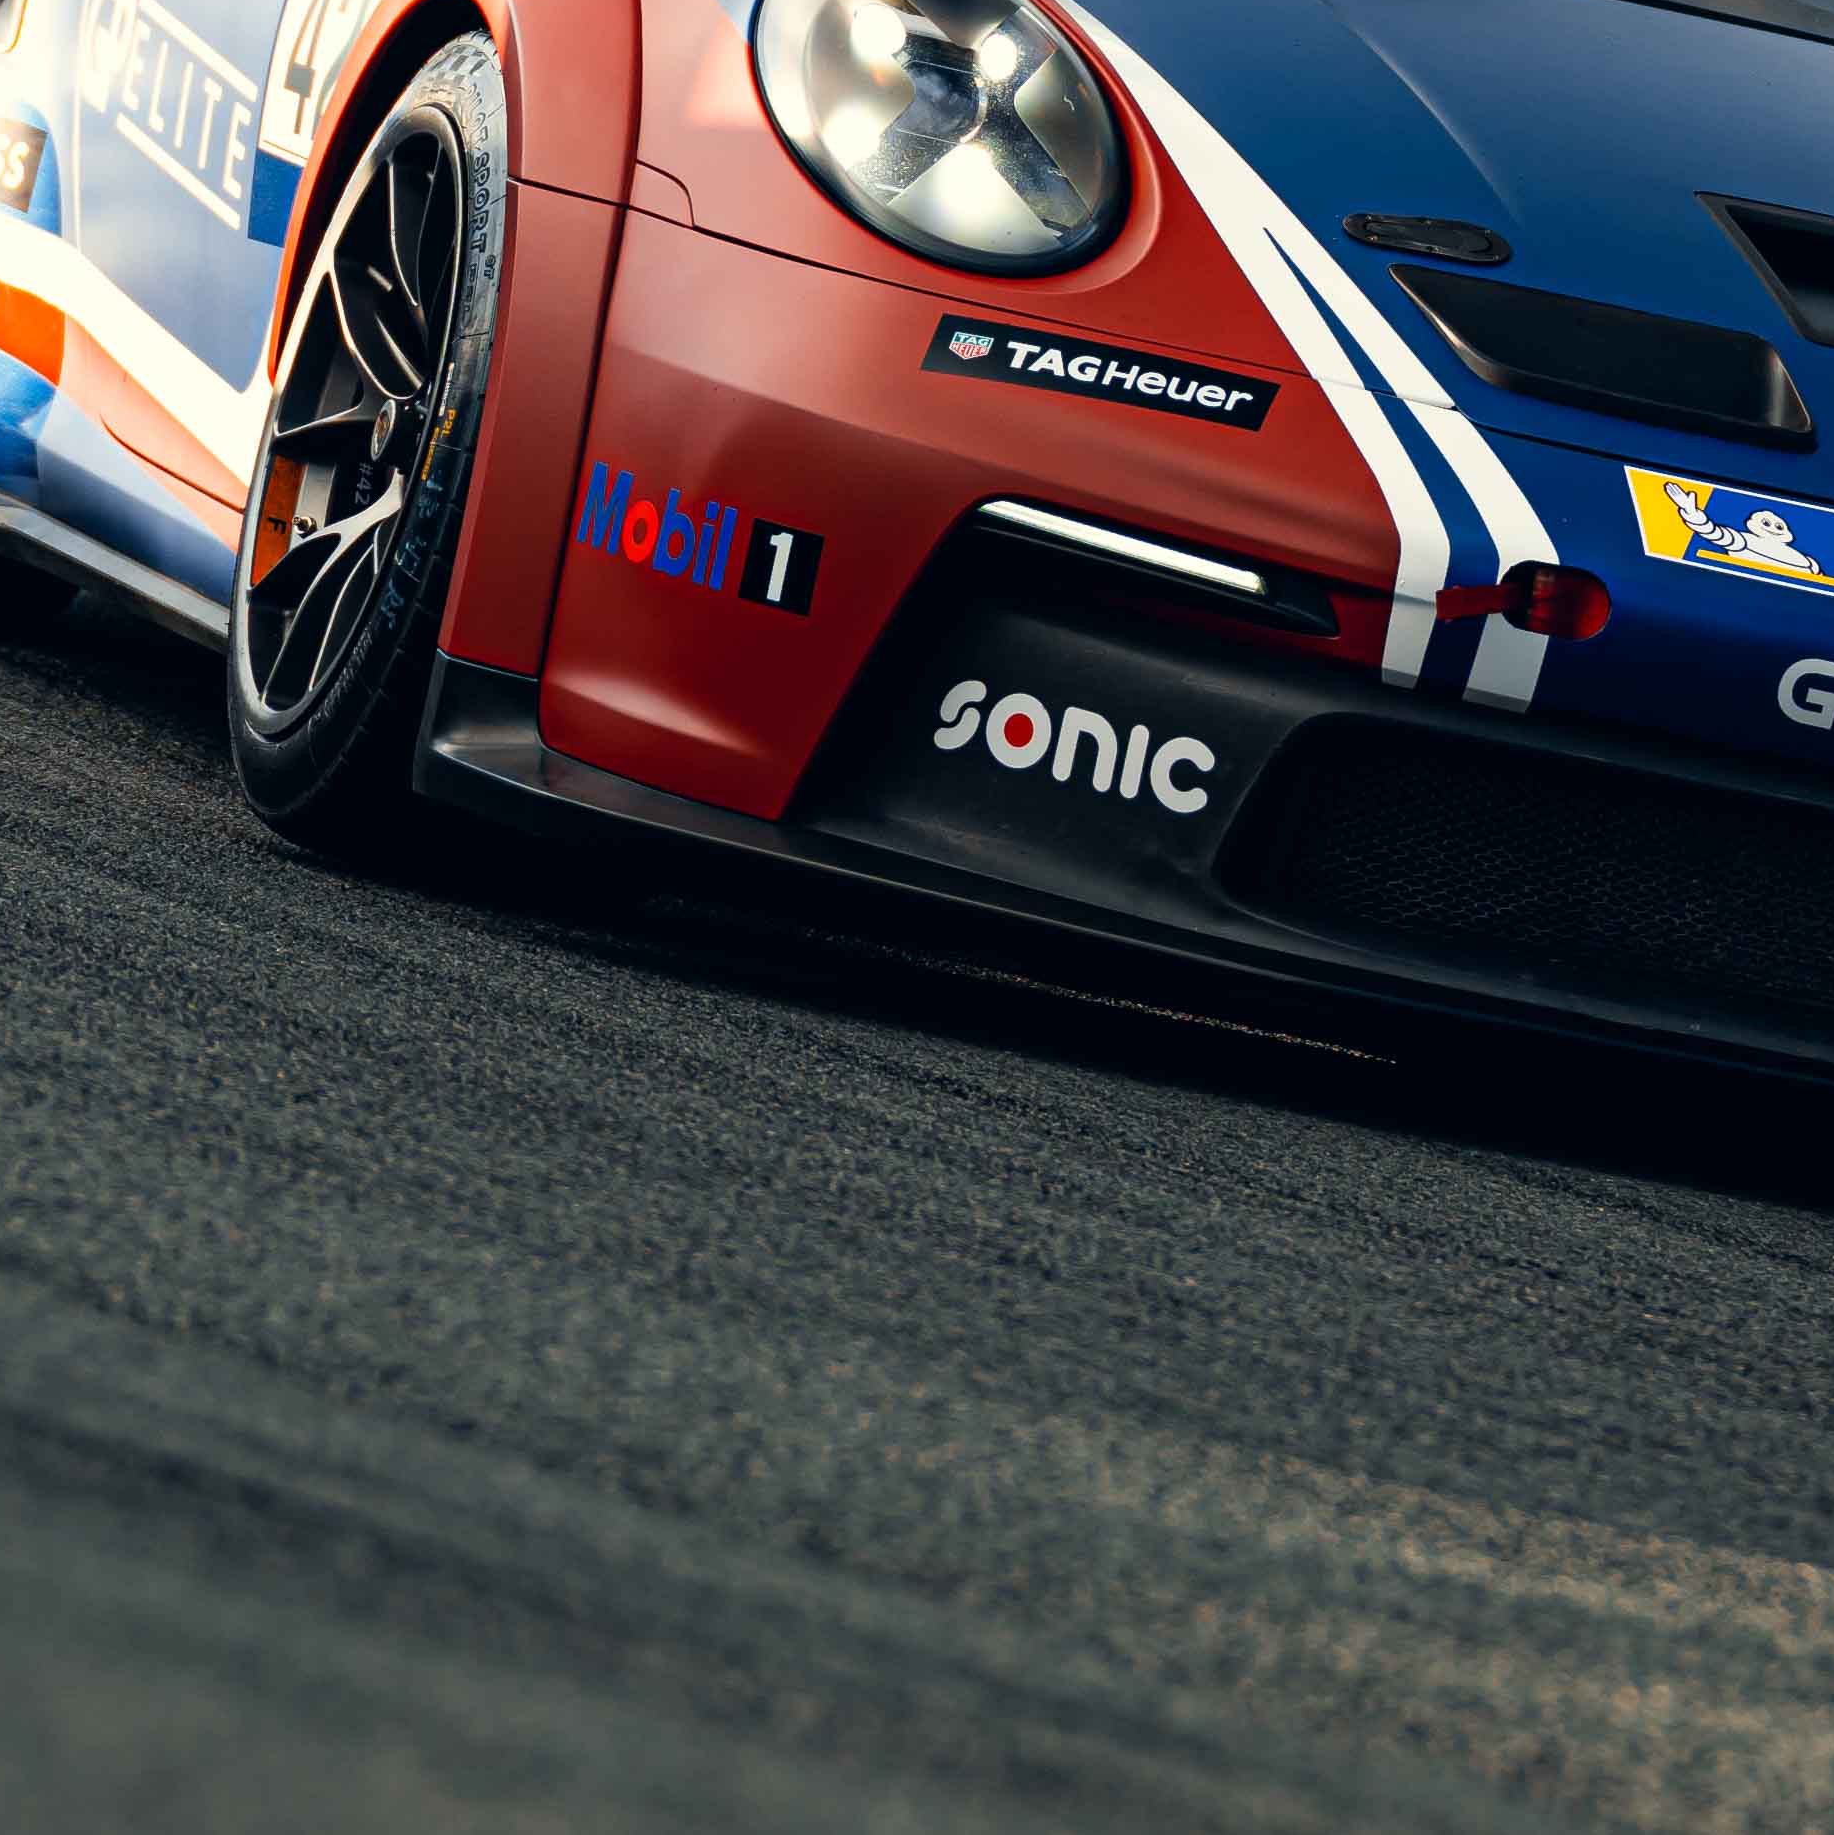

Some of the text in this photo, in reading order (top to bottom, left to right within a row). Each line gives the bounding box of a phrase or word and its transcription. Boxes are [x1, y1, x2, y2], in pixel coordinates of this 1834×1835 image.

[470, 151, 491, 255] SPORT
[957, 334, 990, 347] TAG
[576, 462, 793, 602] Mobil 1
